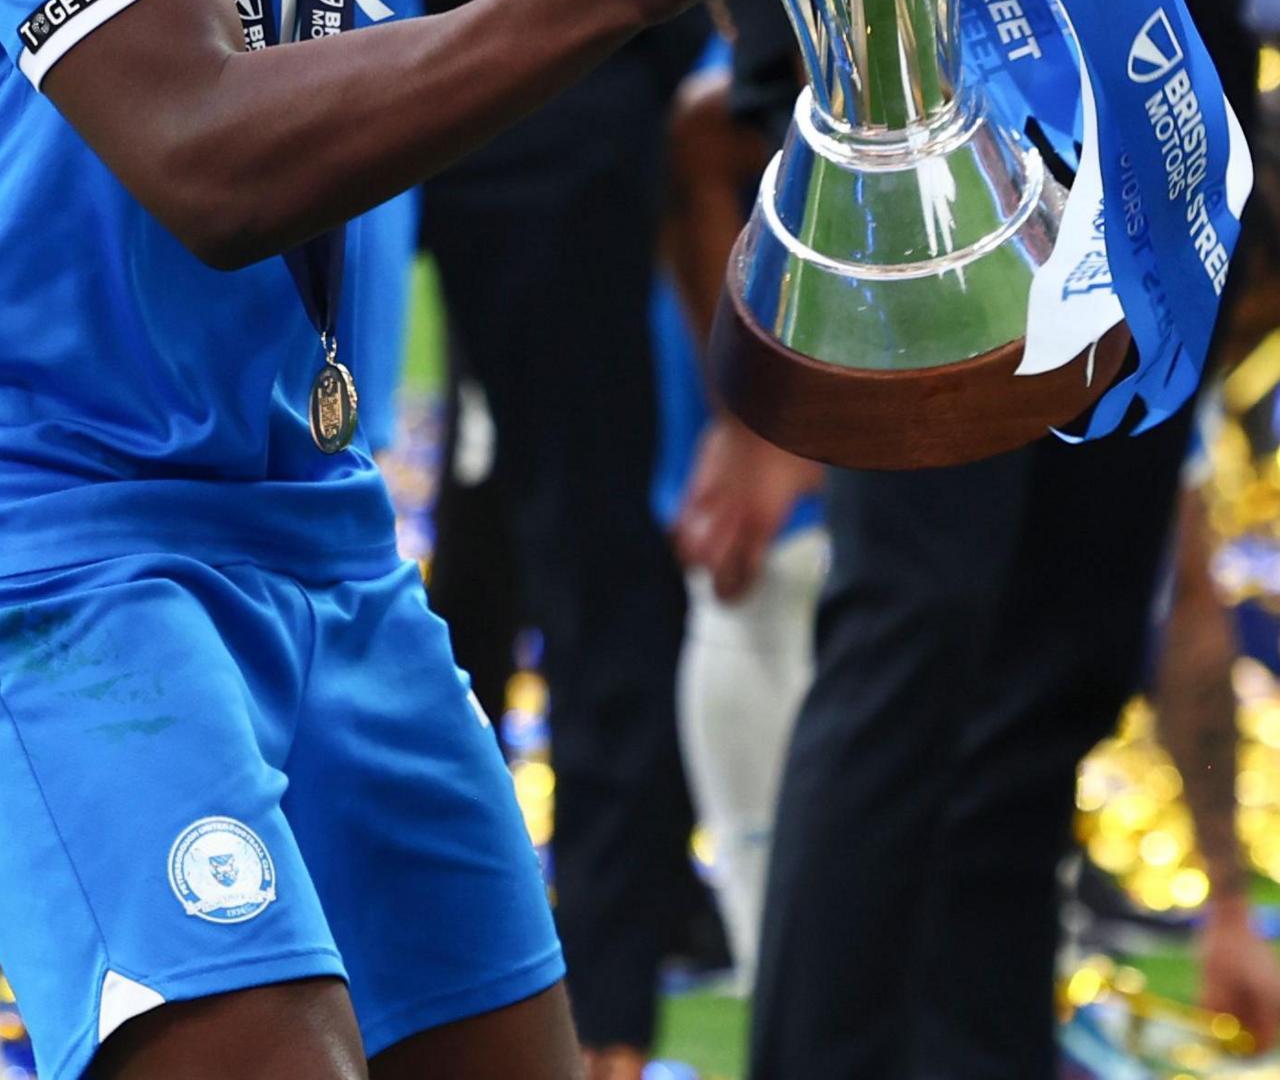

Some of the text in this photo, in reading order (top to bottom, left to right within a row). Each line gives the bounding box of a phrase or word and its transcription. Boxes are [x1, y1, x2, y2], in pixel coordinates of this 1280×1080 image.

[1145, 89, 1186, 201] MOTORS
[1164, 68, 1229, 296] BRISTOL STREE
